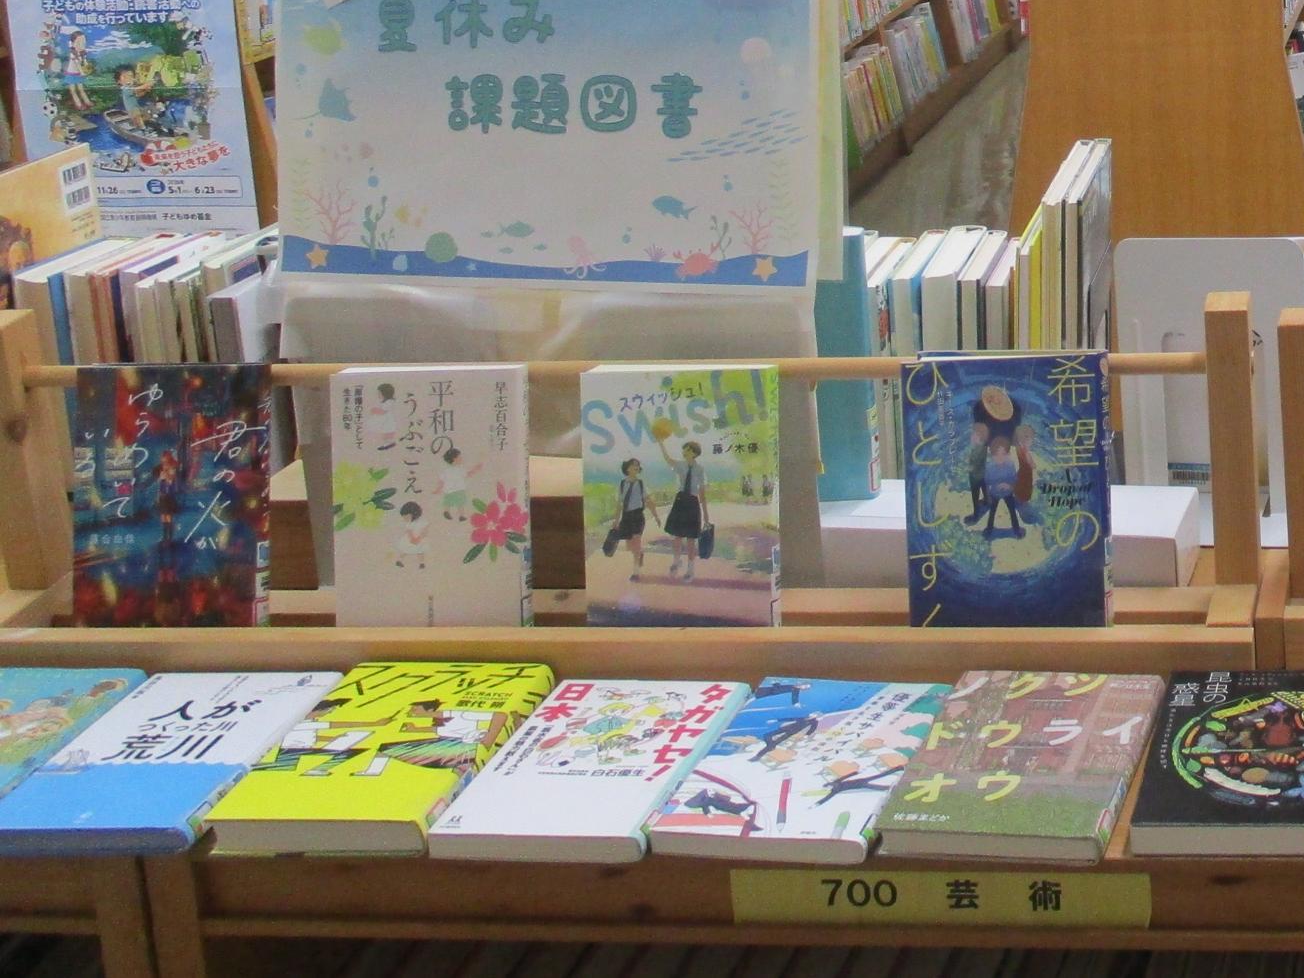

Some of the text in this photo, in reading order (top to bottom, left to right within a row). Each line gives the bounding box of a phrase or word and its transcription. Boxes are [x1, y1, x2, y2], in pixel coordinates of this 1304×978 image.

[444, 72, 703, 140] 課題図書
[173, 146, 230, 172] 大きな夢を
[161, 212, 212, 221] 子どもゆめ基金
[581, 368, 769, 455] Swish!
[619, 381, 704, 413] スウィッシュ!
[428, 379, 457, 457] 平和の
[494, 380, 508, 452] 早志百合子
[399, 391, 425, 495] うぶごえ
[1045, 356, 1100, 553] 希望の
[184, 420, 268, 551] 君の火が
[330, 663, 543, 708] スクラッチ
[534, 683, 596, 722] 日本
[1168, 681, 1201, 707] 惑星
[1203, 670, 1233, 704] 昆虫の
[138, 721, 239, 733] つくった川
[148, 699, 263, 721] 人が
[101, 733, 225, 760] 荒川
[644, 683, 734, 783] タガヤセ!
[903, 769, 1022, 803] オウ
[820, 879, 1064, 913] 700 芸術
